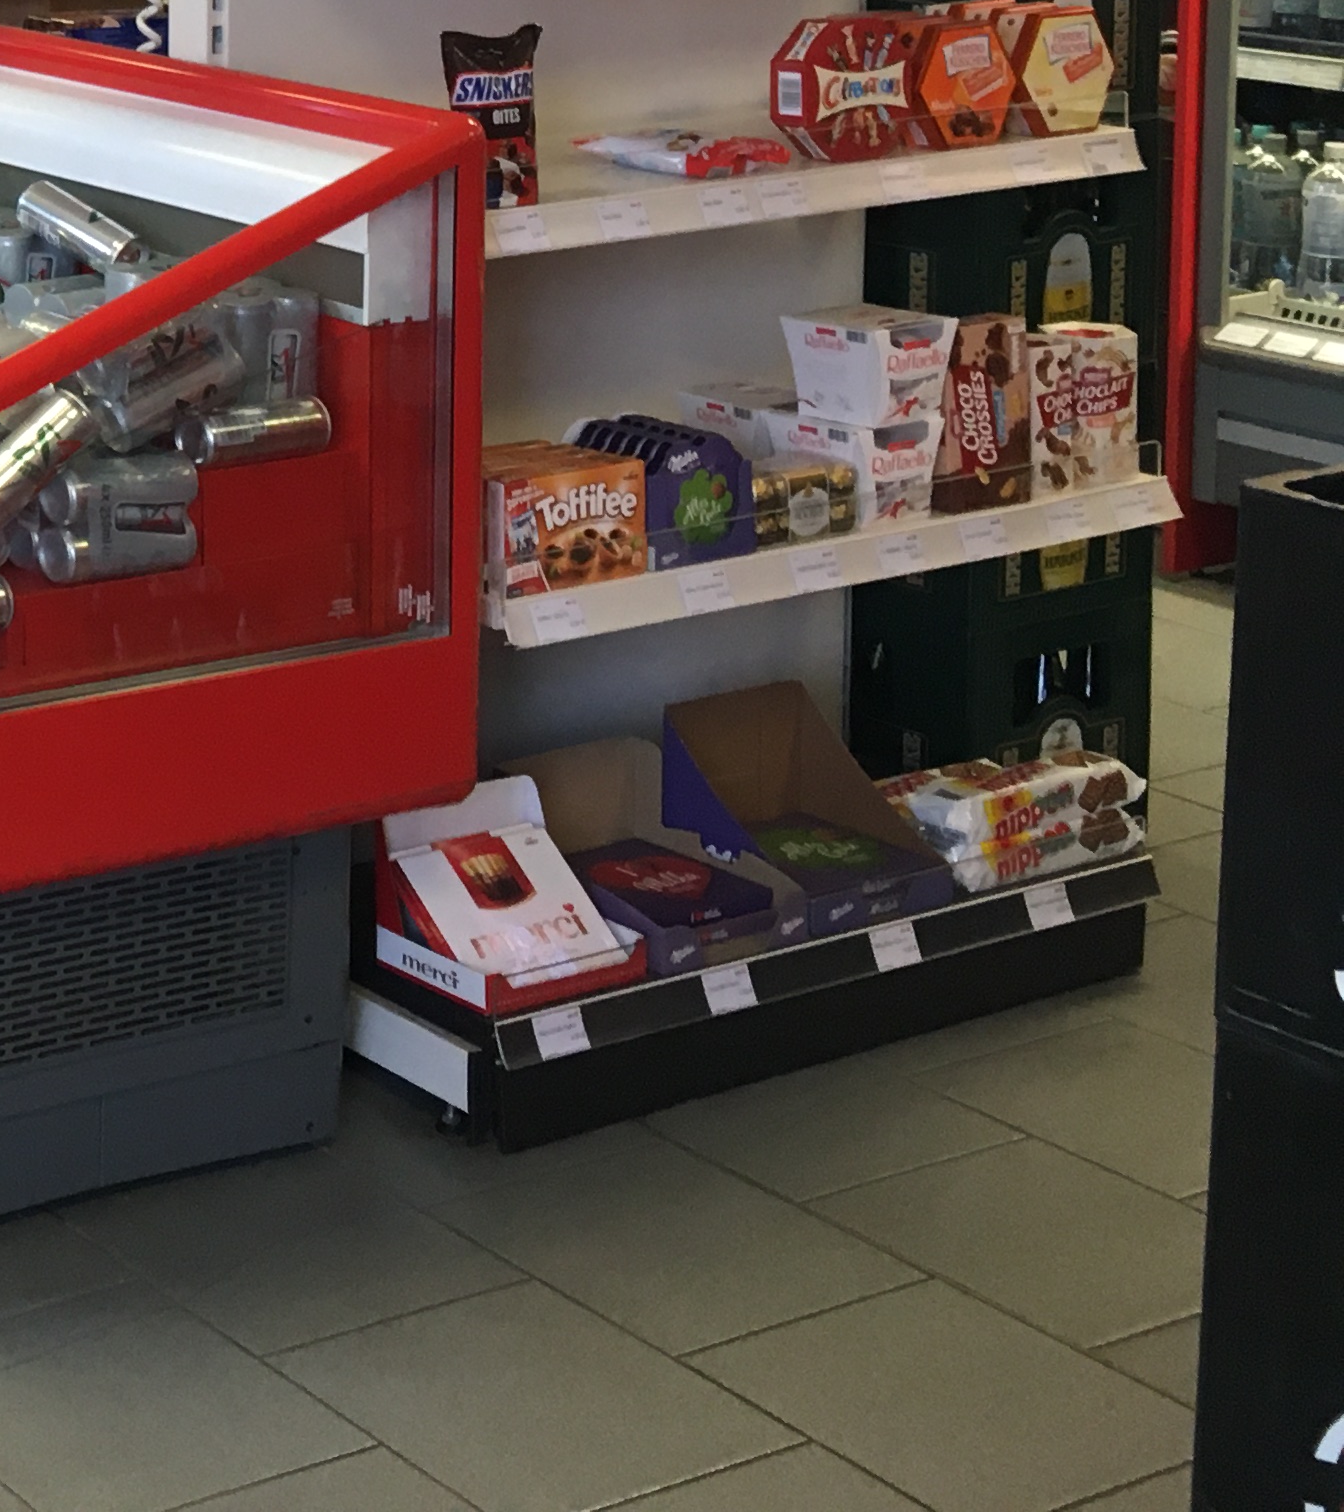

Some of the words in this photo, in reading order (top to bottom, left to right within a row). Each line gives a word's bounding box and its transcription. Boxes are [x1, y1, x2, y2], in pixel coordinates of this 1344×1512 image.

[492, 107, 521, 126] BITES
[886, 347, 949, 374] Raffaello
[957, 382, 981, 453] CHOCO
[969, 370, 999, 466] CROSSIES
[1075, 395, 1119, 418] CHIPS
[871, 449, 933, 477] Raffaello
[535, 483, 638, 533] Toffifee
[470, 903, 590, 960] merci
[402, 951, 460, 991] merci
